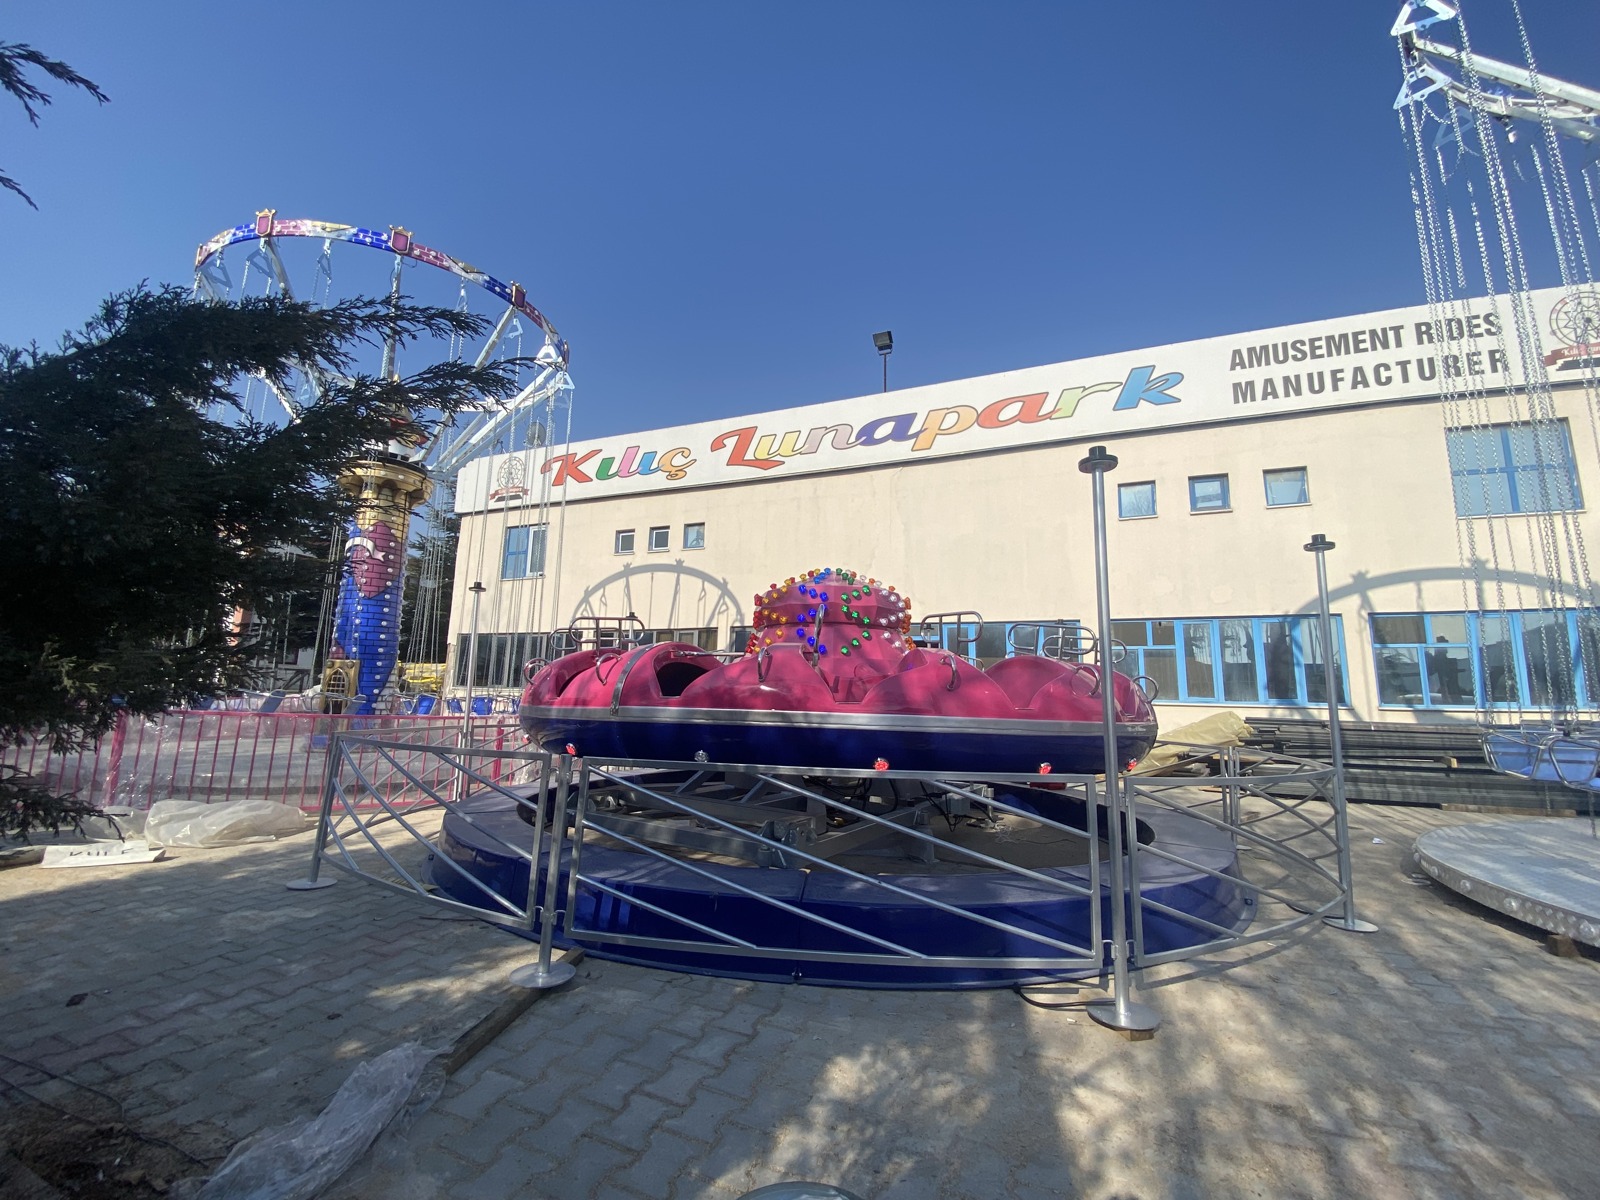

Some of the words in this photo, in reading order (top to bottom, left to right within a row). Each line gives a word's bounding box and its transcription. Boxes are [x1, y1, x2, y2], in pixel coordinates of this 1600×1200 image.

[1230, 325, 1404, 371] AMUSEMENT
[1414, 312, 1502, 345] RIDES
[1232, 349, 1510, 404] MANUFACTURER
[541, 446, 697, 486] Kılıç
[711, 365, 1184, 470] Lunapark
